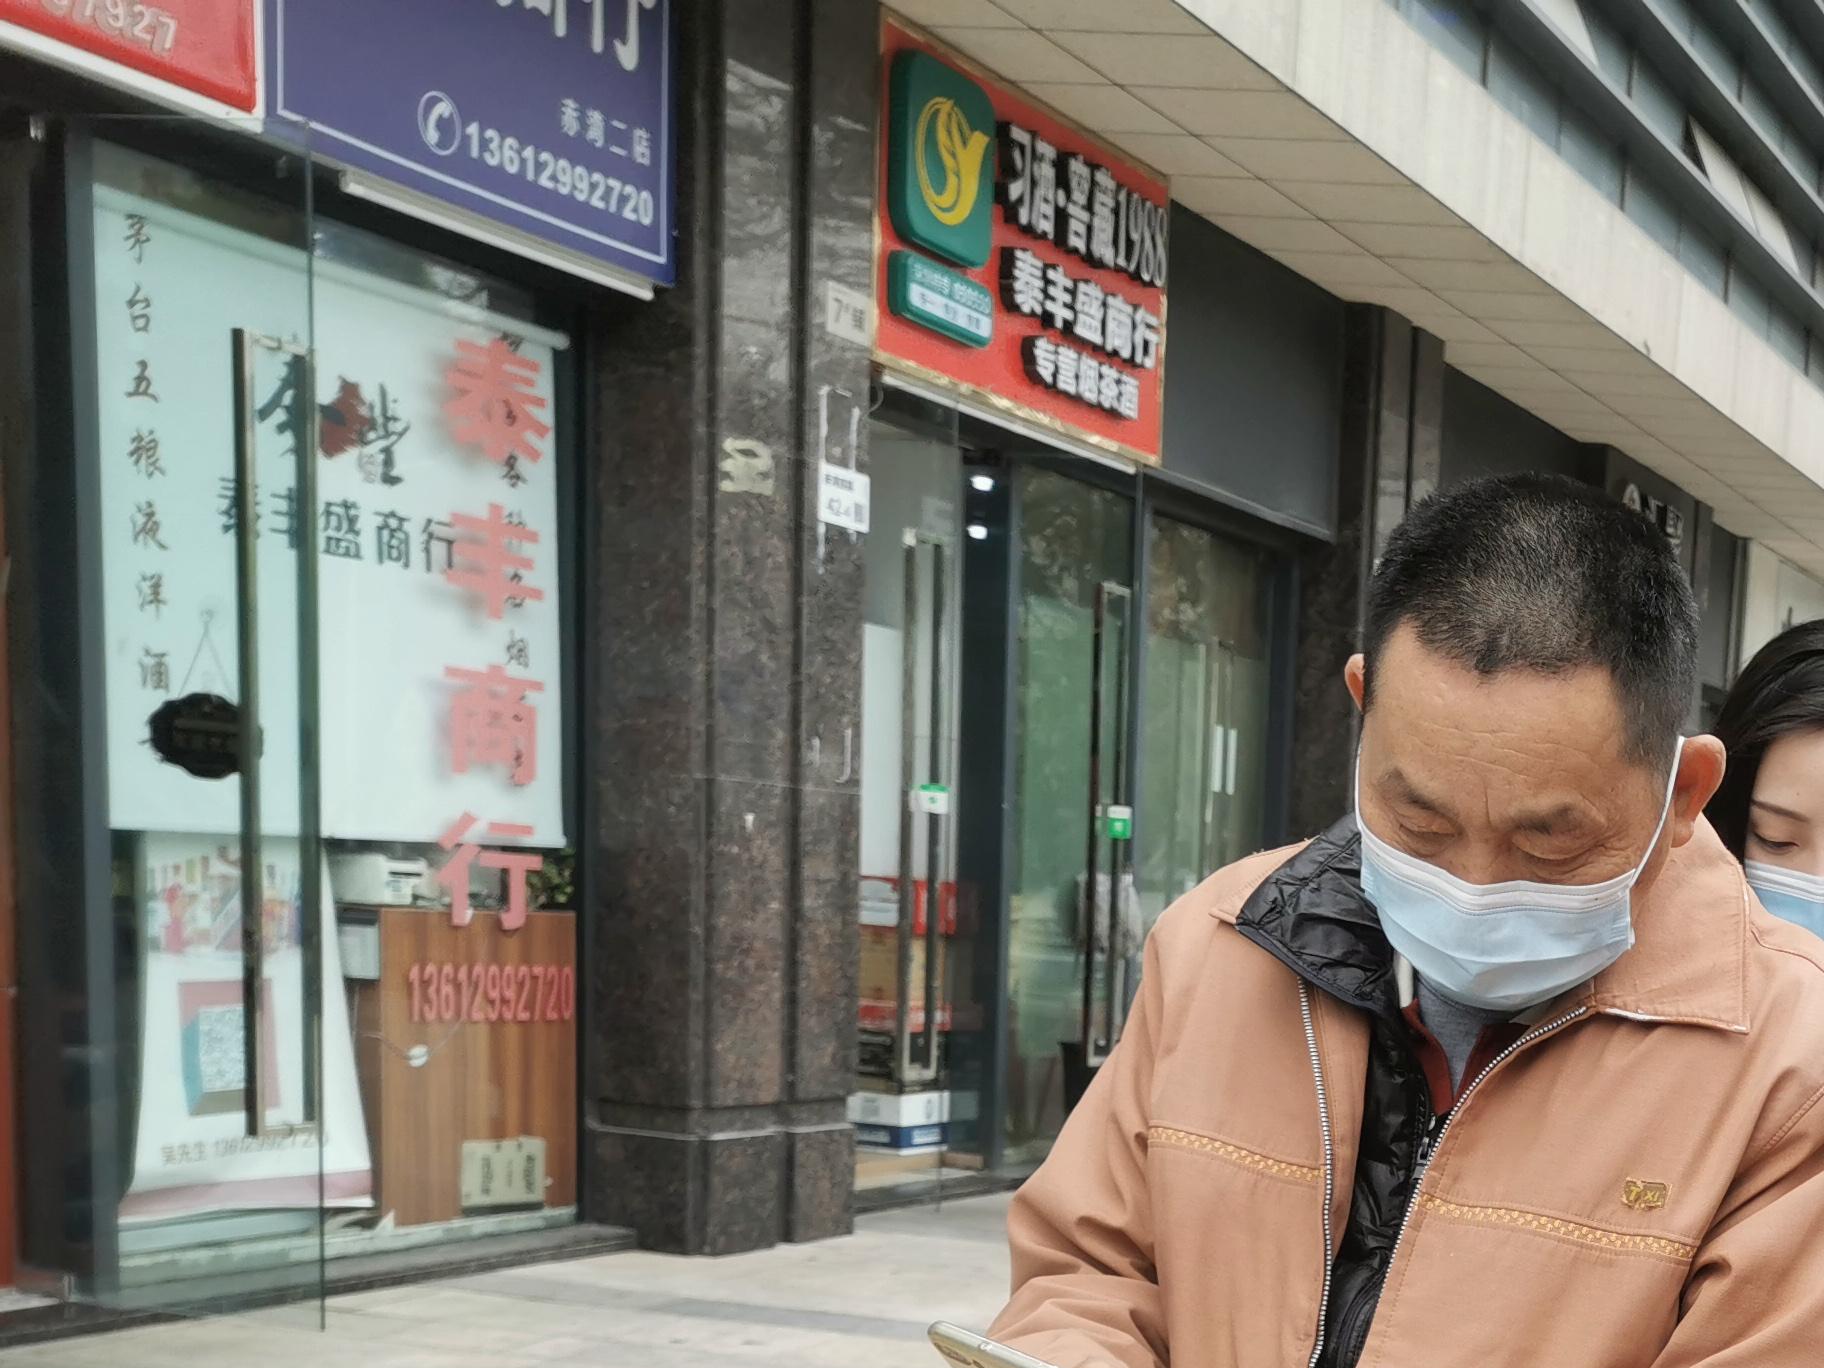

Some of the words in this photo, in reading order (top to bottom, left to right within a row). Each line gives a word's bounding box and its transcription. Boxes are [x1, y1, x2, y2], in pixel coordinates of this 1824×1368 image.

[465, 120, 655, 227] 13612992720
[1012, 247, 1161, 370] 泰丰盛商行
[408, 961, 575, 1023] 13612992720
